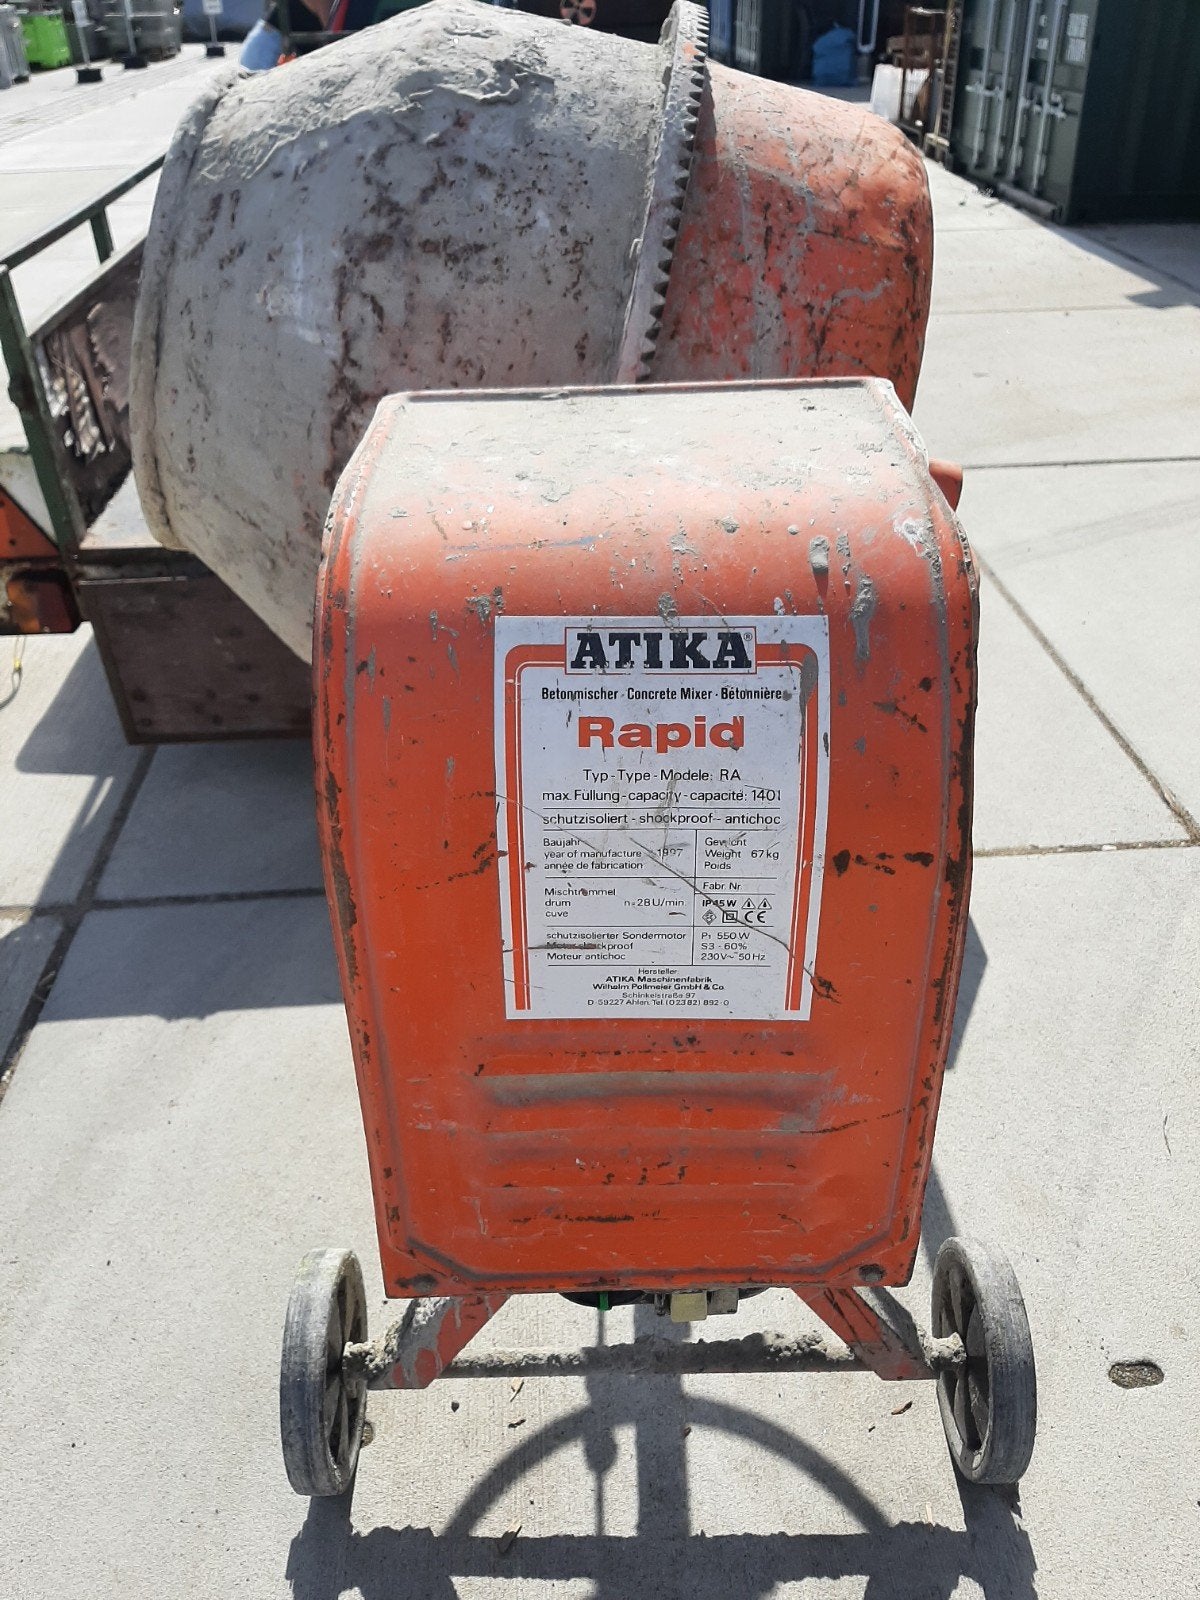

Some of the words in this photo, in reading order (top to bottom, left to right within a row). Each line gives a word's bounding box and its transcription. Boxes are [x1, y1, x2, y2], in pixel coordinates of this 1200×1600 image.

[627, 687, 676, 700] Concrete
[680, 687, 712, 700] Mixer
[721, 687, 782, 700] Bétonnière
[578, 716, 744, 754] Rapid
[583, 769, 608, 783] Typ
[617, 769, 650, 783] Type
[720, 769, 741, 780] RA
[543, 813, 628, 825] schutzisoliert
[640, 812, 713, 825] shockproof
[725, 813, 780, 824] antichoc
[543, 838, 580, 848] Baujahr
[544, 850, 564, 859] year
[567, 849, 578, 858] of
[580, 850, 642, 858] manufacture
[705, 850, 741, 860] Weight
[751, 850, 764, 858] 67
[766, 849, 779, 860] kg
[544, 861, 574, 870] année
[576, 861, 588, 870] de
[591, 861, 643, 870] fabrication
[544, 888, 616, 896] Mischtrmmel
[545, 899, 571, 907] drum
[546, 910, 568, 918] cuve
[744, 911, 766, 923] CE
[546, 931, 618, 940] schutzisolierter
[622, 931, 686, 940] Sondermotor
